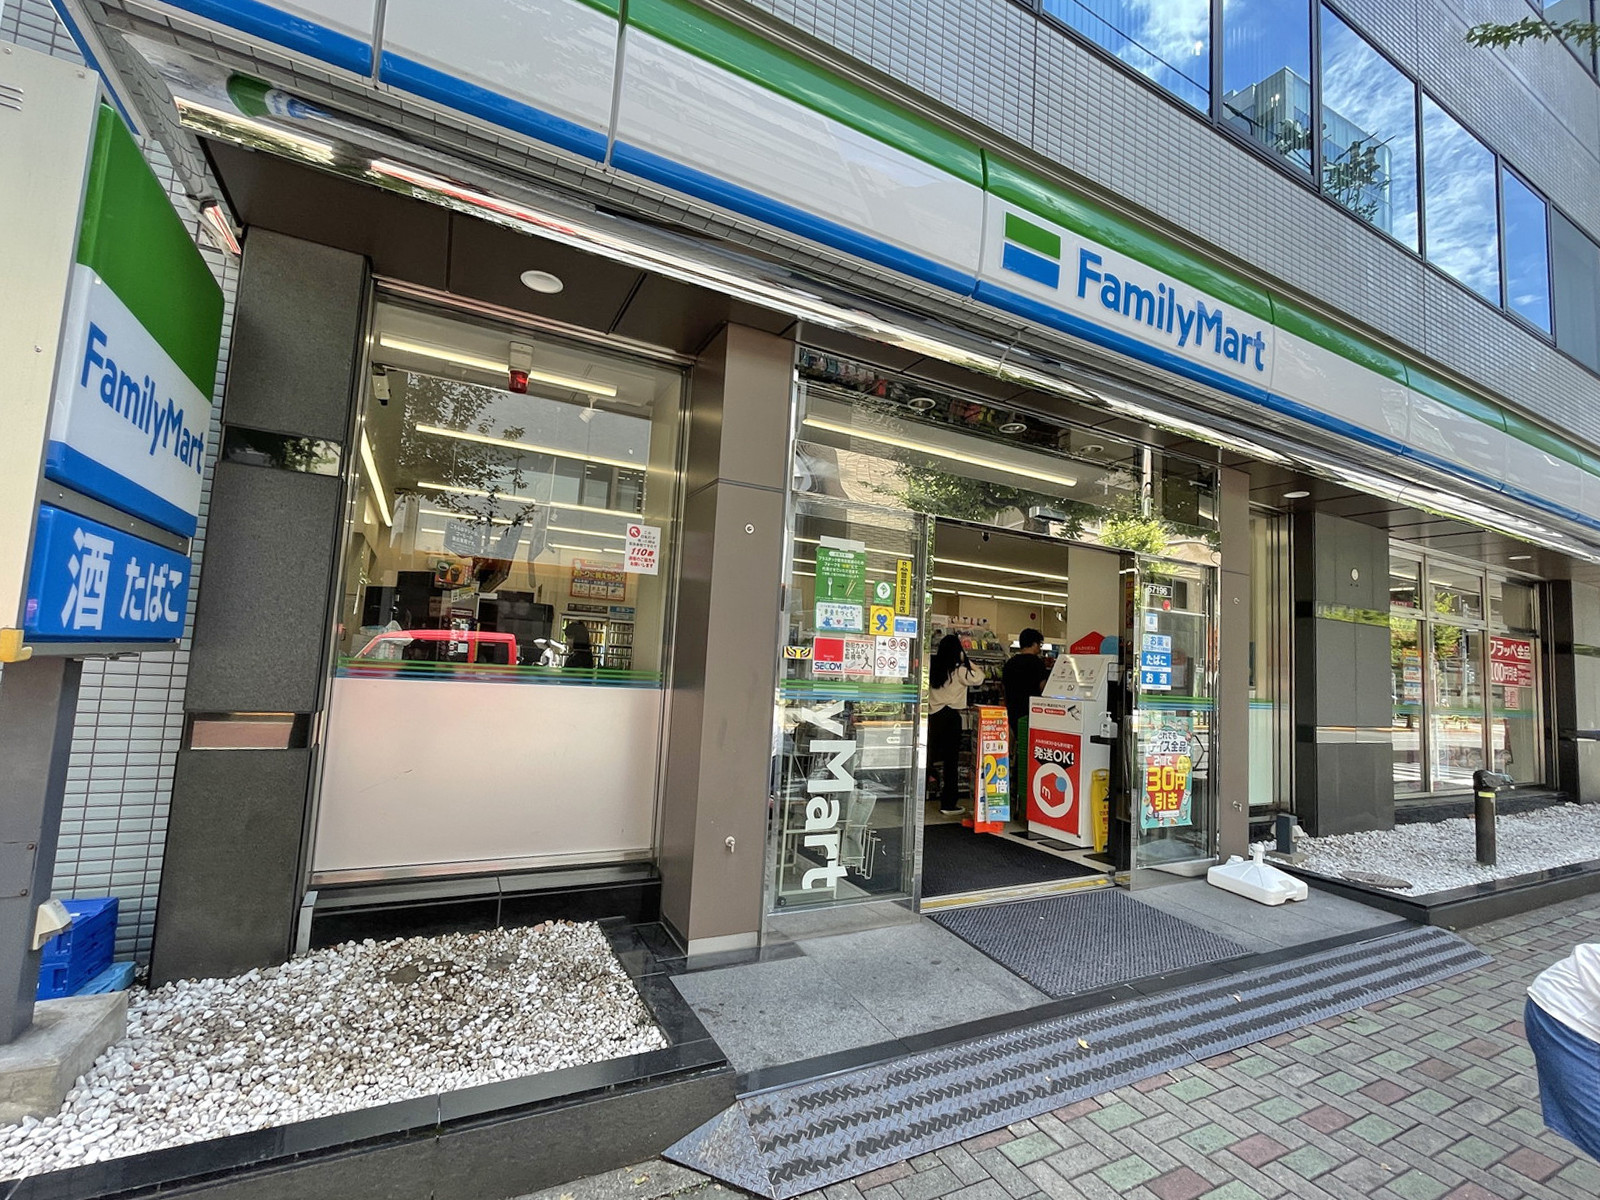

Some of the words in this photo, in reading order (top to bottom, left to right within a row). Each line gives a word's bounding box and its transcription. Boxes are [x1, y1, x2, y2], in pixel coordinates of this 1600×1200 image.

[1078, 248, 1265, 371] FamilyMart
[81, 321, 204, 475] FamilyMart
[61, 527, 114, 630] 酒
[120, 556, 183, 623] たばこ
[1146, 654, 1167, 665] たばこ
[1490, 641, 1531, 660] フラッペ全品
[814, 661, 842, 671] SECOM
[1491, 662, 1518, 682] 100円引き
[1034, 746, 1074, 765] 発送OK!
[1147, 766, 1187, 791] 30円
[1155, 792, 1178, 811] 引き
